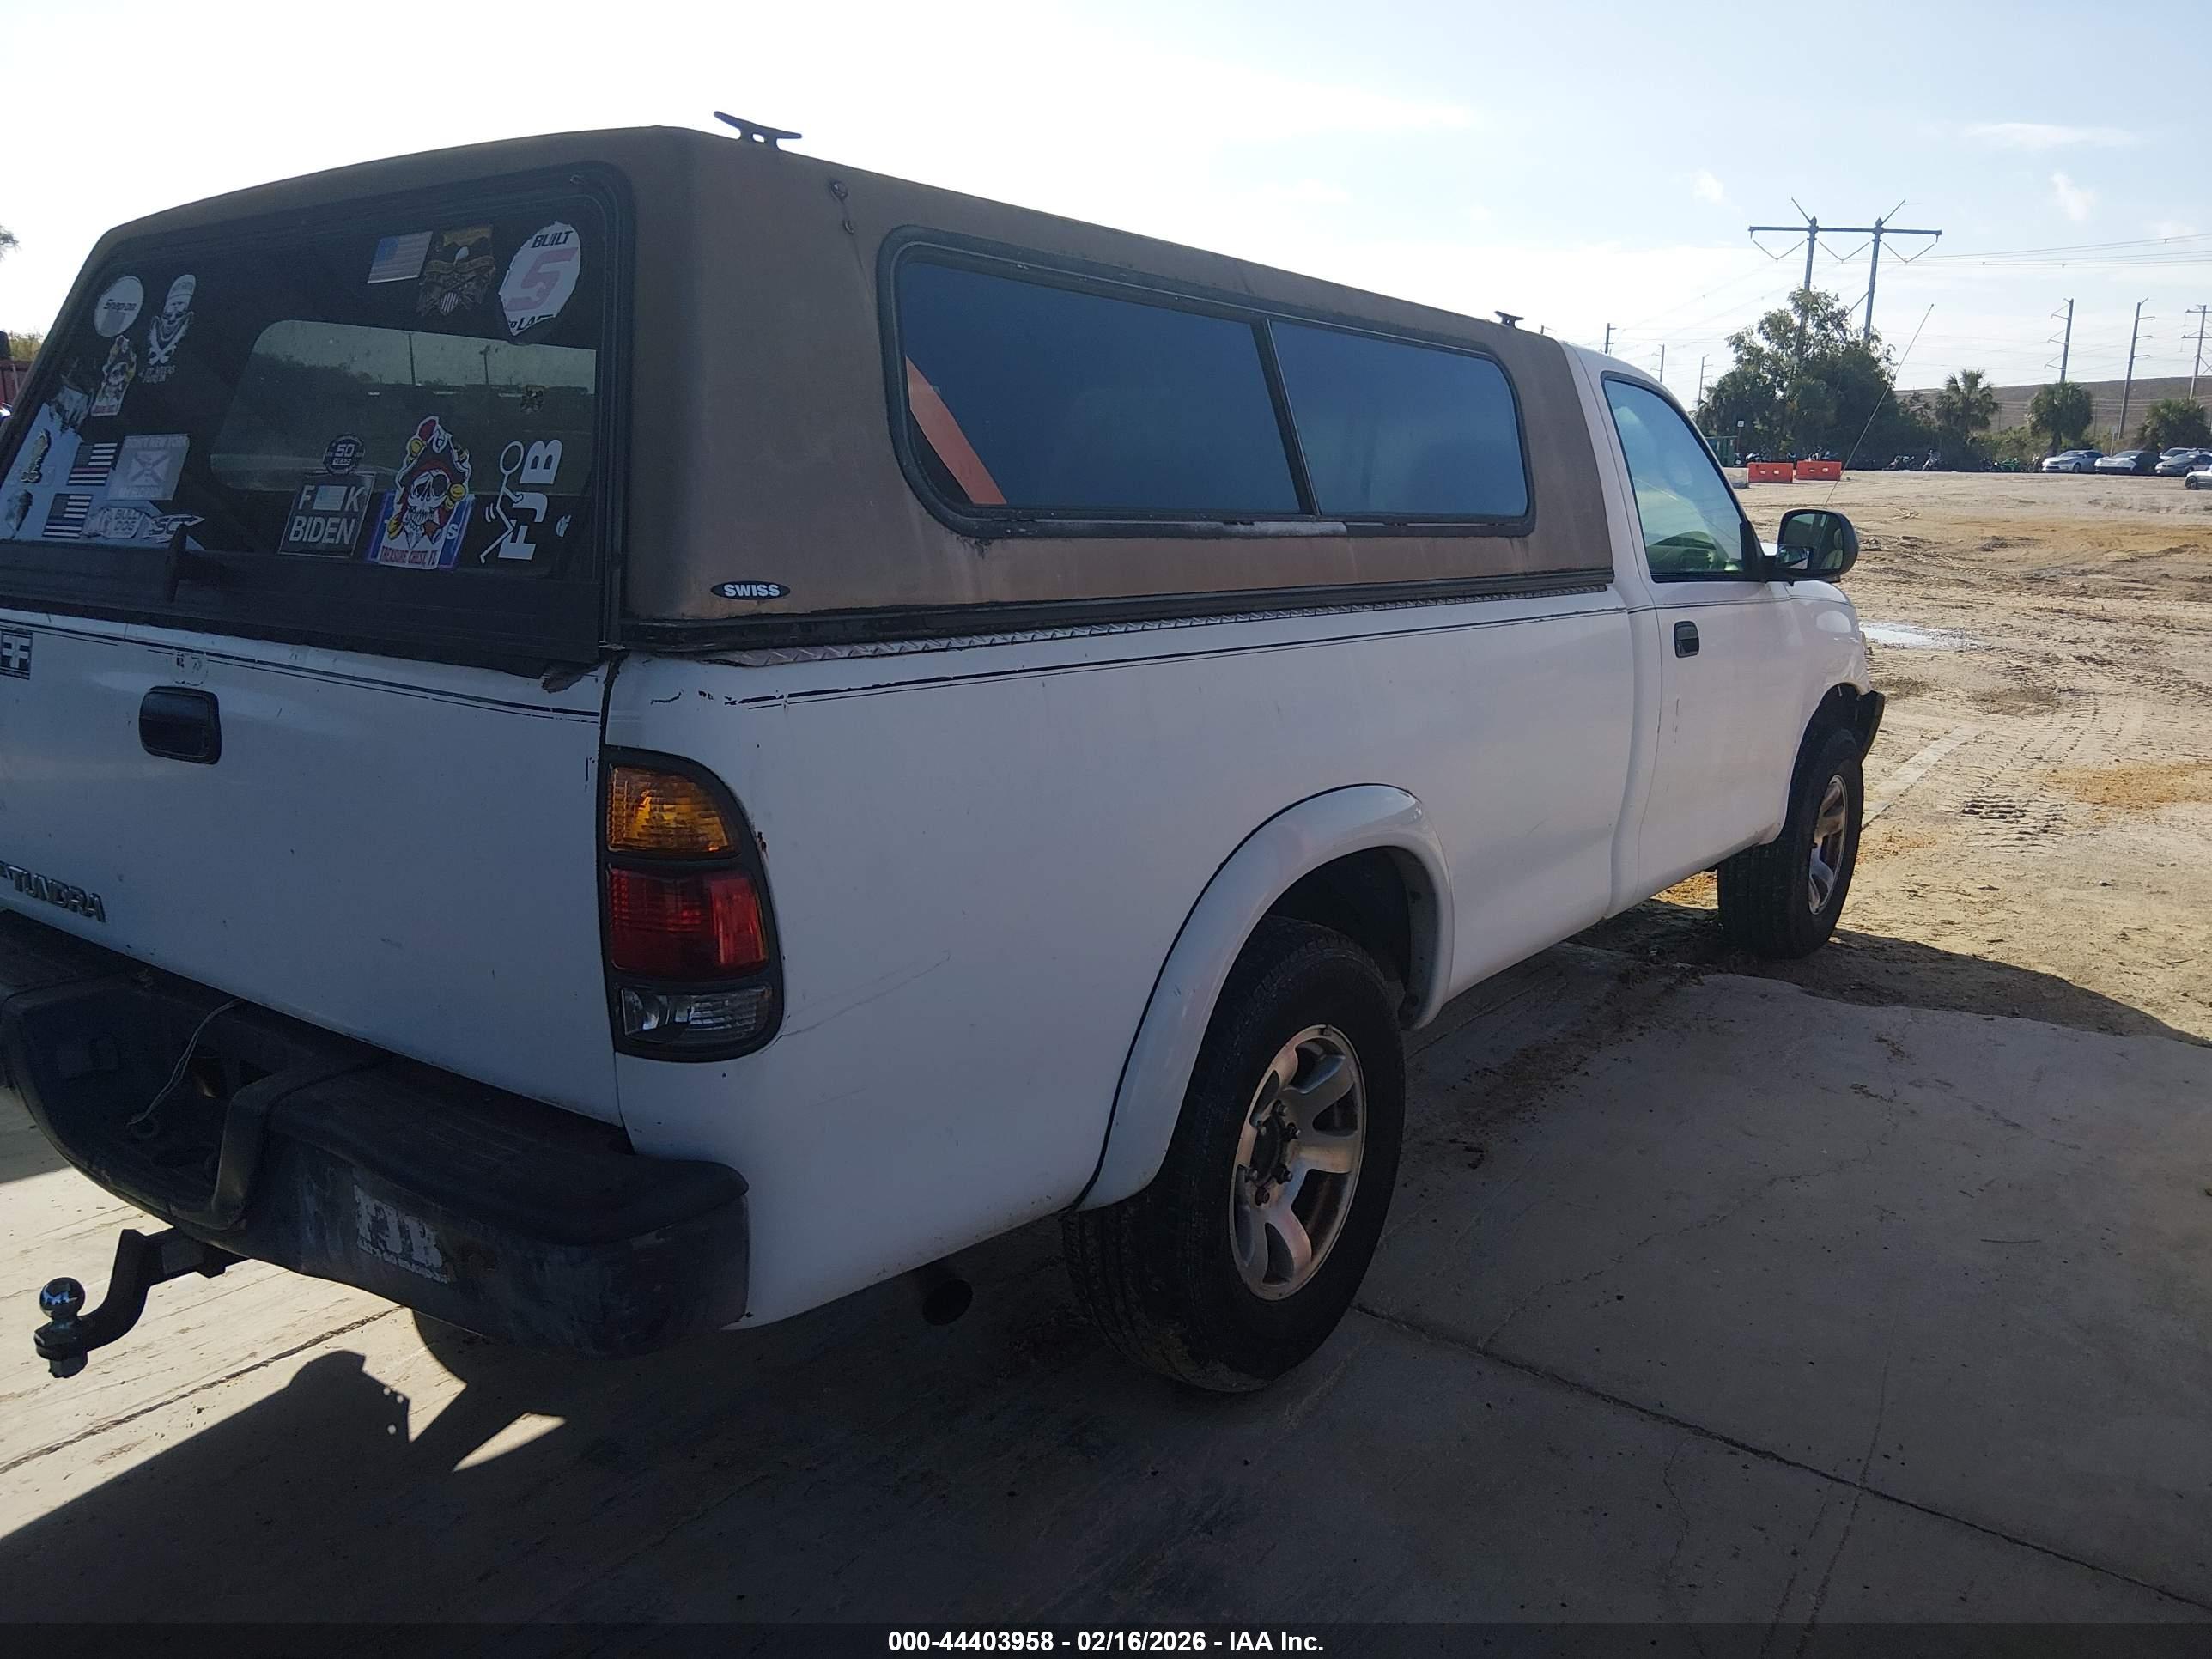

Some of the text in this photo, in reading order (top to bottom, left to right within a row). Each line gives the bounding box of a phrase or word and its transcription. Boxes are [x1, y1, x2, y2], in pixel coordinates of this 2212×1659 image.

[531, 230, 574, 249] BUILT
[334, 443, 356, 458] 50
[289, 515, 356, 544] BIDEN
[723, 583, 781, 598] SWISS
